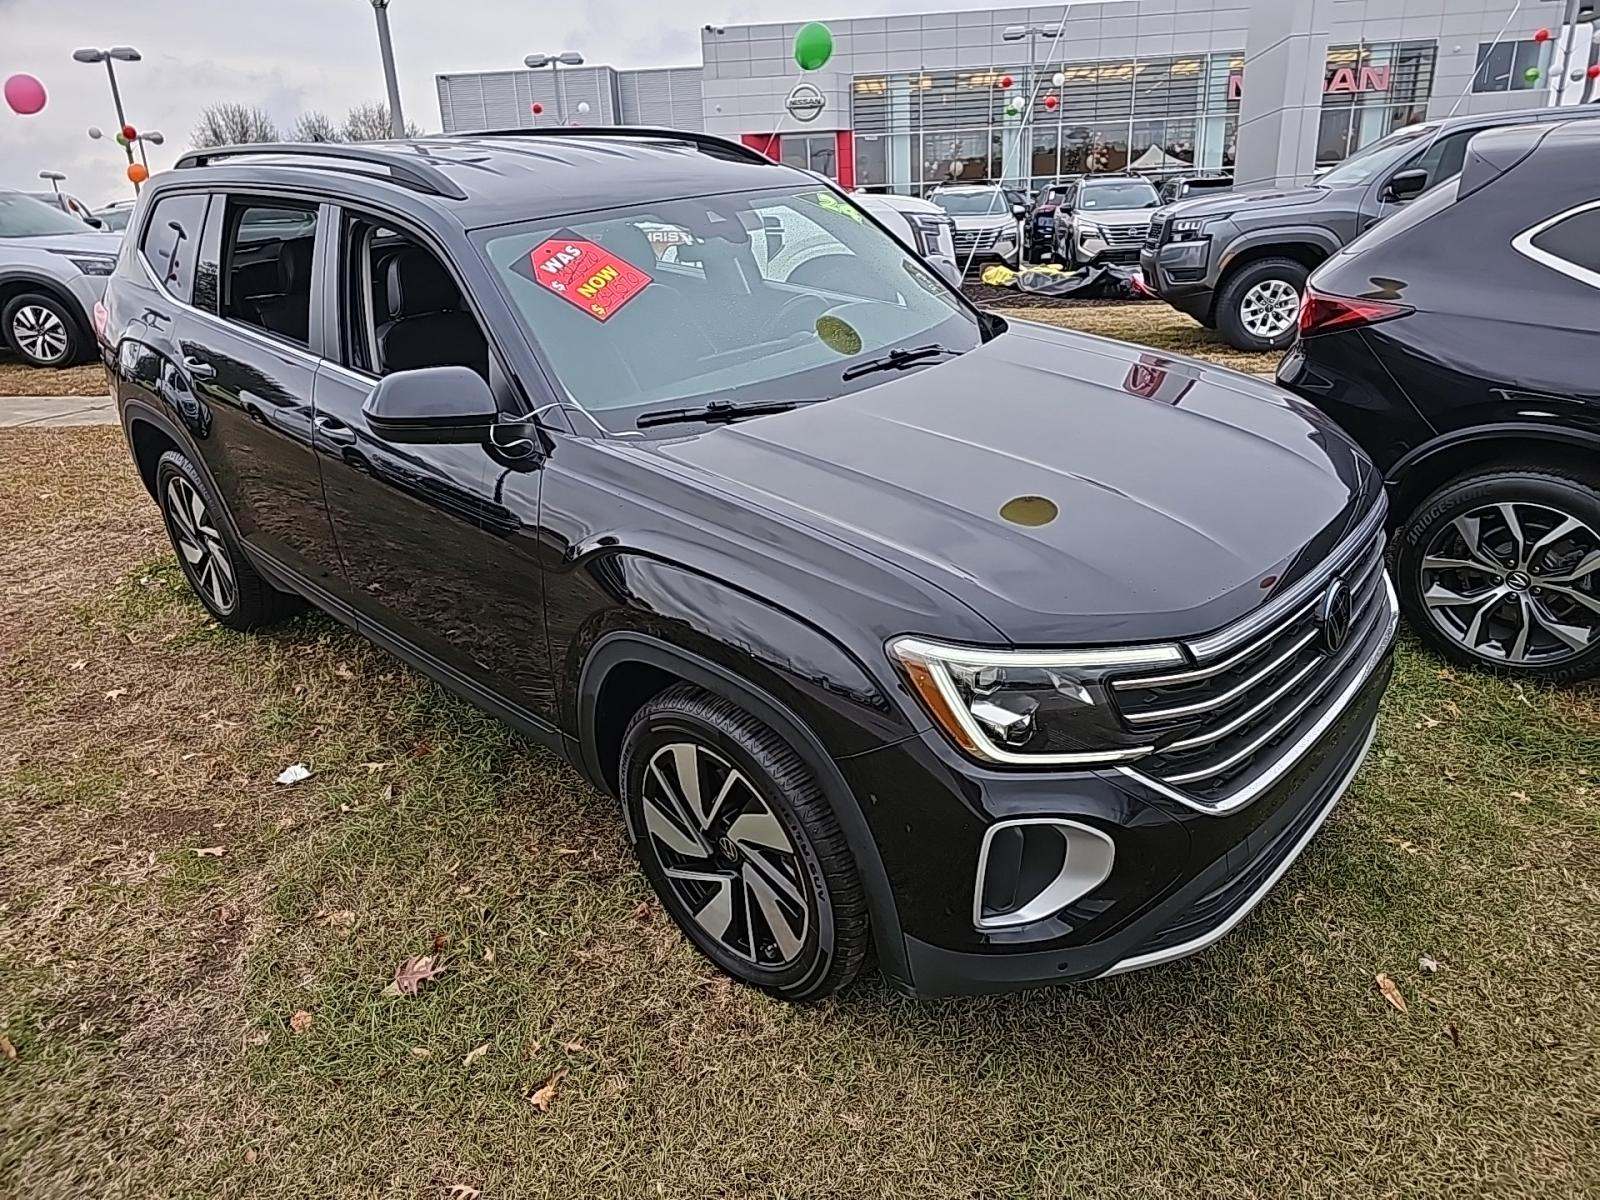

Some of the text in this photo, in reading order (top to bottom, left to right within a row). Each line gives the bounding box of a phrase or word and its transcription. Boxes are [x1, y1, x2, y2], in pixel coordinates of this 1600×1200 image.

[789, 98, 821, 107] NISSAN
[539, 245, 582, 274] WAS
[577, 264, 620, 298] NOW
